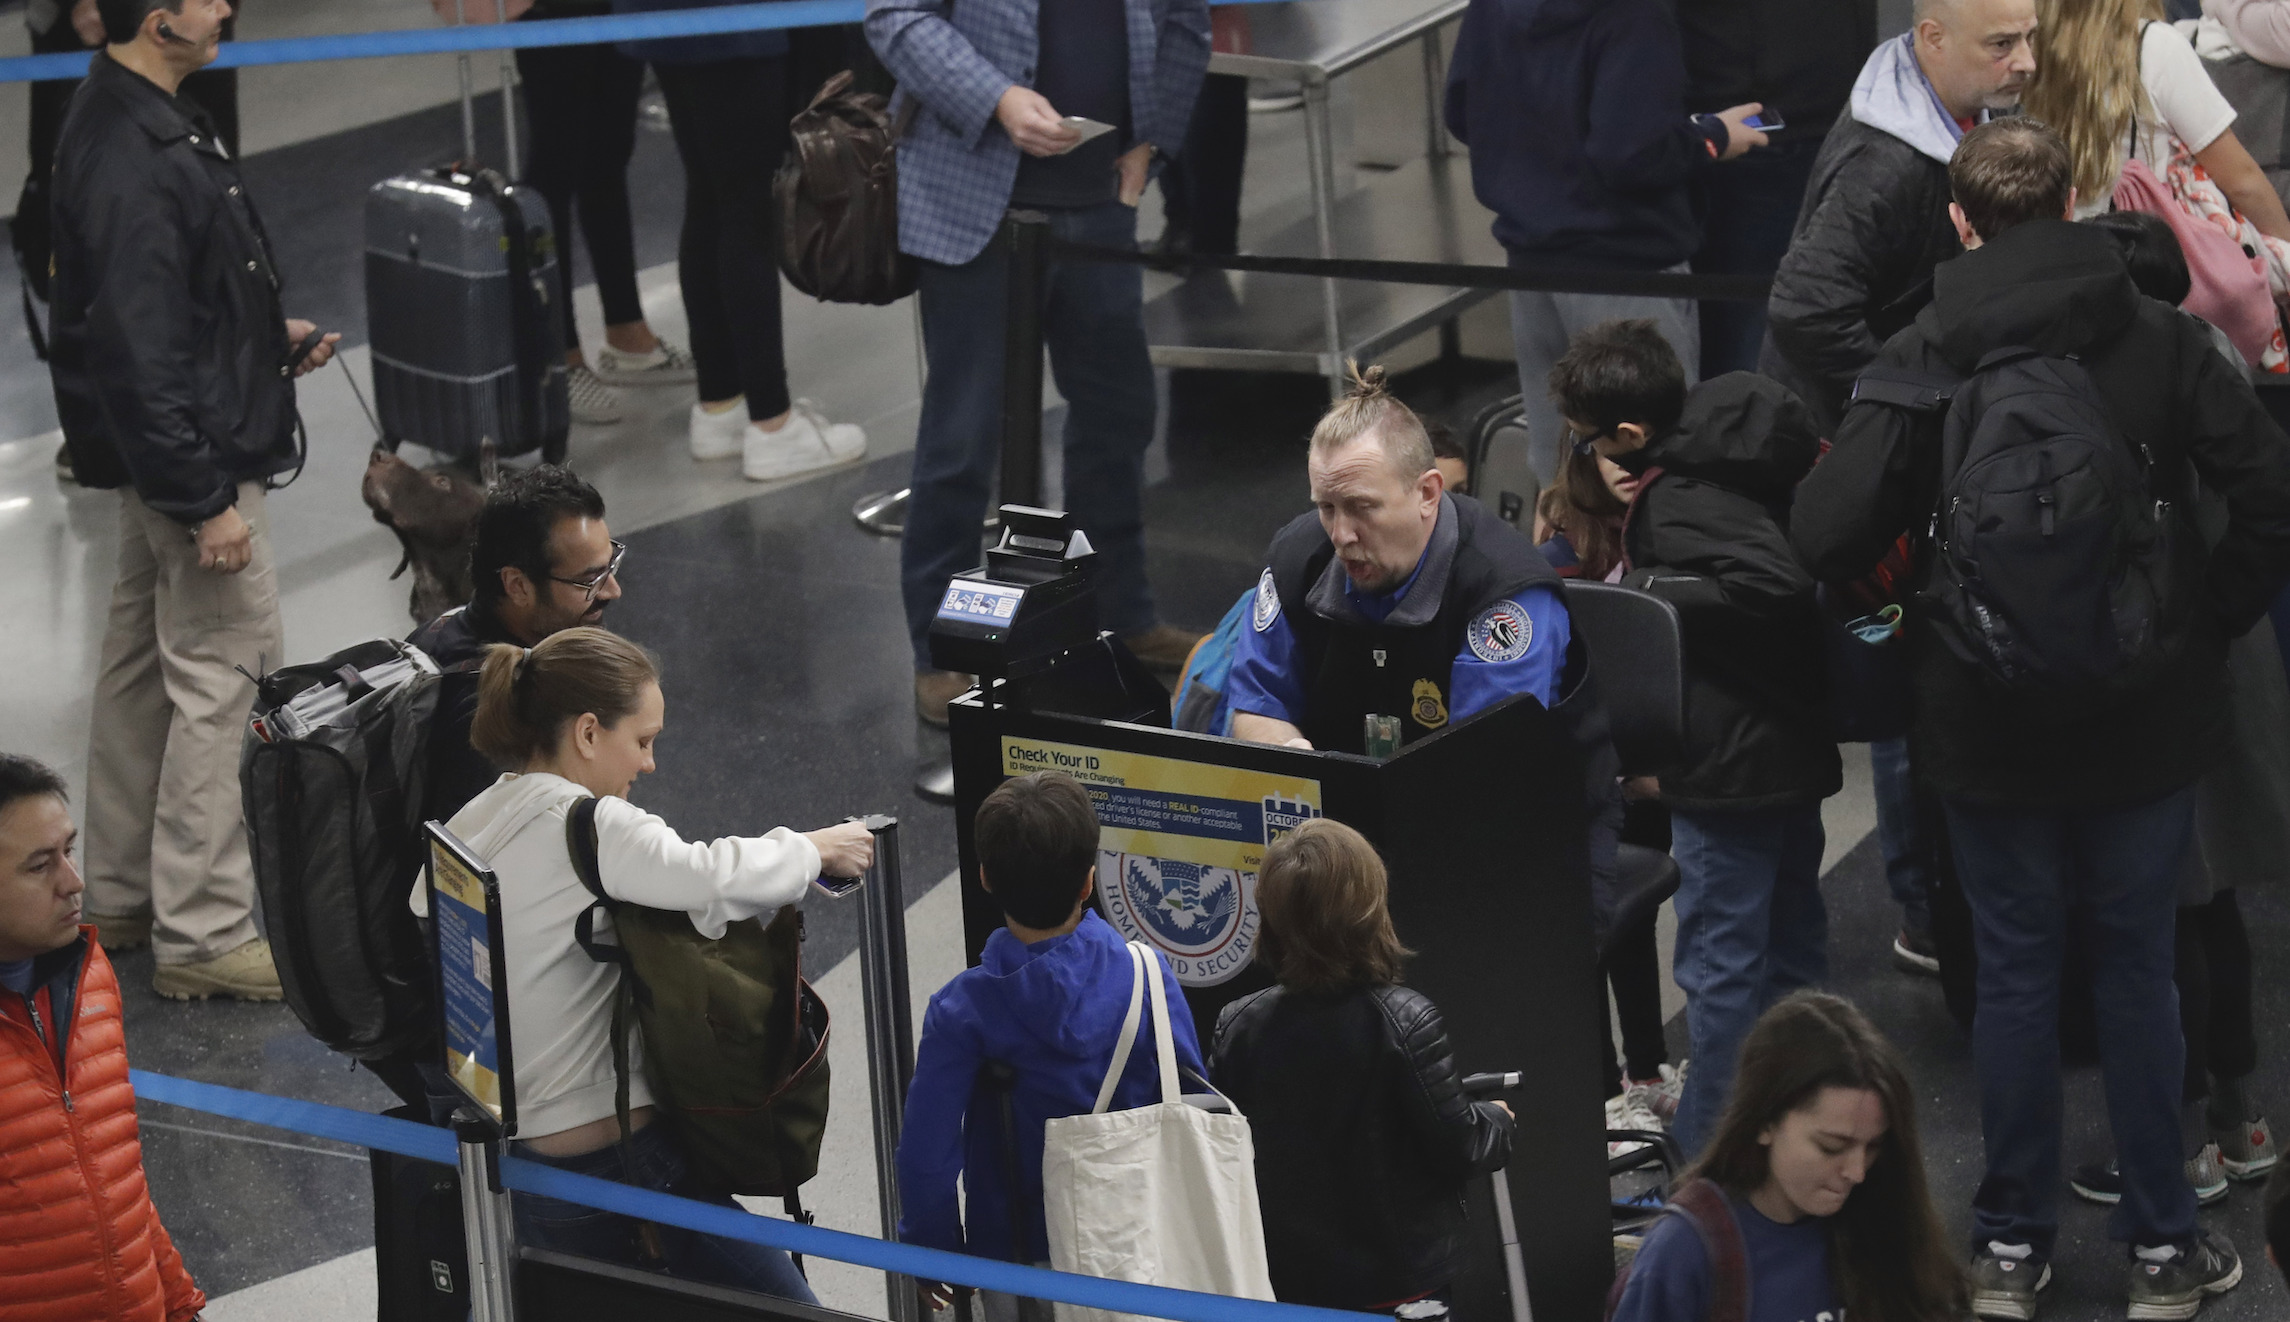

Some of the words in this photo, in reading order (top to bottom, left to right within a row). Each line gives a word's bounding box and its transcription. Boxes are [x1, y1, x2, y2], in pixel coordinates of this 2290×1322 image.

[1009, 746, 1048, 763] Check
[1051, 751, 1082, 767] Your
[1086, 756, 1099, 770] ID
[1075, 770, 1088, 780] Are
[1090, 772, 1125, 786] Changing
[1111, 794, 1126, 803] you
[1128, 795, 1141, 805] will
[1143, 798, 1161, 808] need
[1162, 801, 1167, 809] a
[1169, 801, 1189, 812] REAL
[1098, 811, 1110, 821] the
[1111, 813, 1137, 825] United
[1106, 803, 1135, 815] driver's
[1136, 807, 1161, 818] license
[1162, 812, 1171, 820] or
[1172, 814, 1201, 824] another
[1203, 817, 1242, 831] acceptable
[1266, 813, 1305, 826] OCTOBE
[1106, 885, 1189, 974] HOMEND
[1197, 904, 1258, 977] SECURITY
